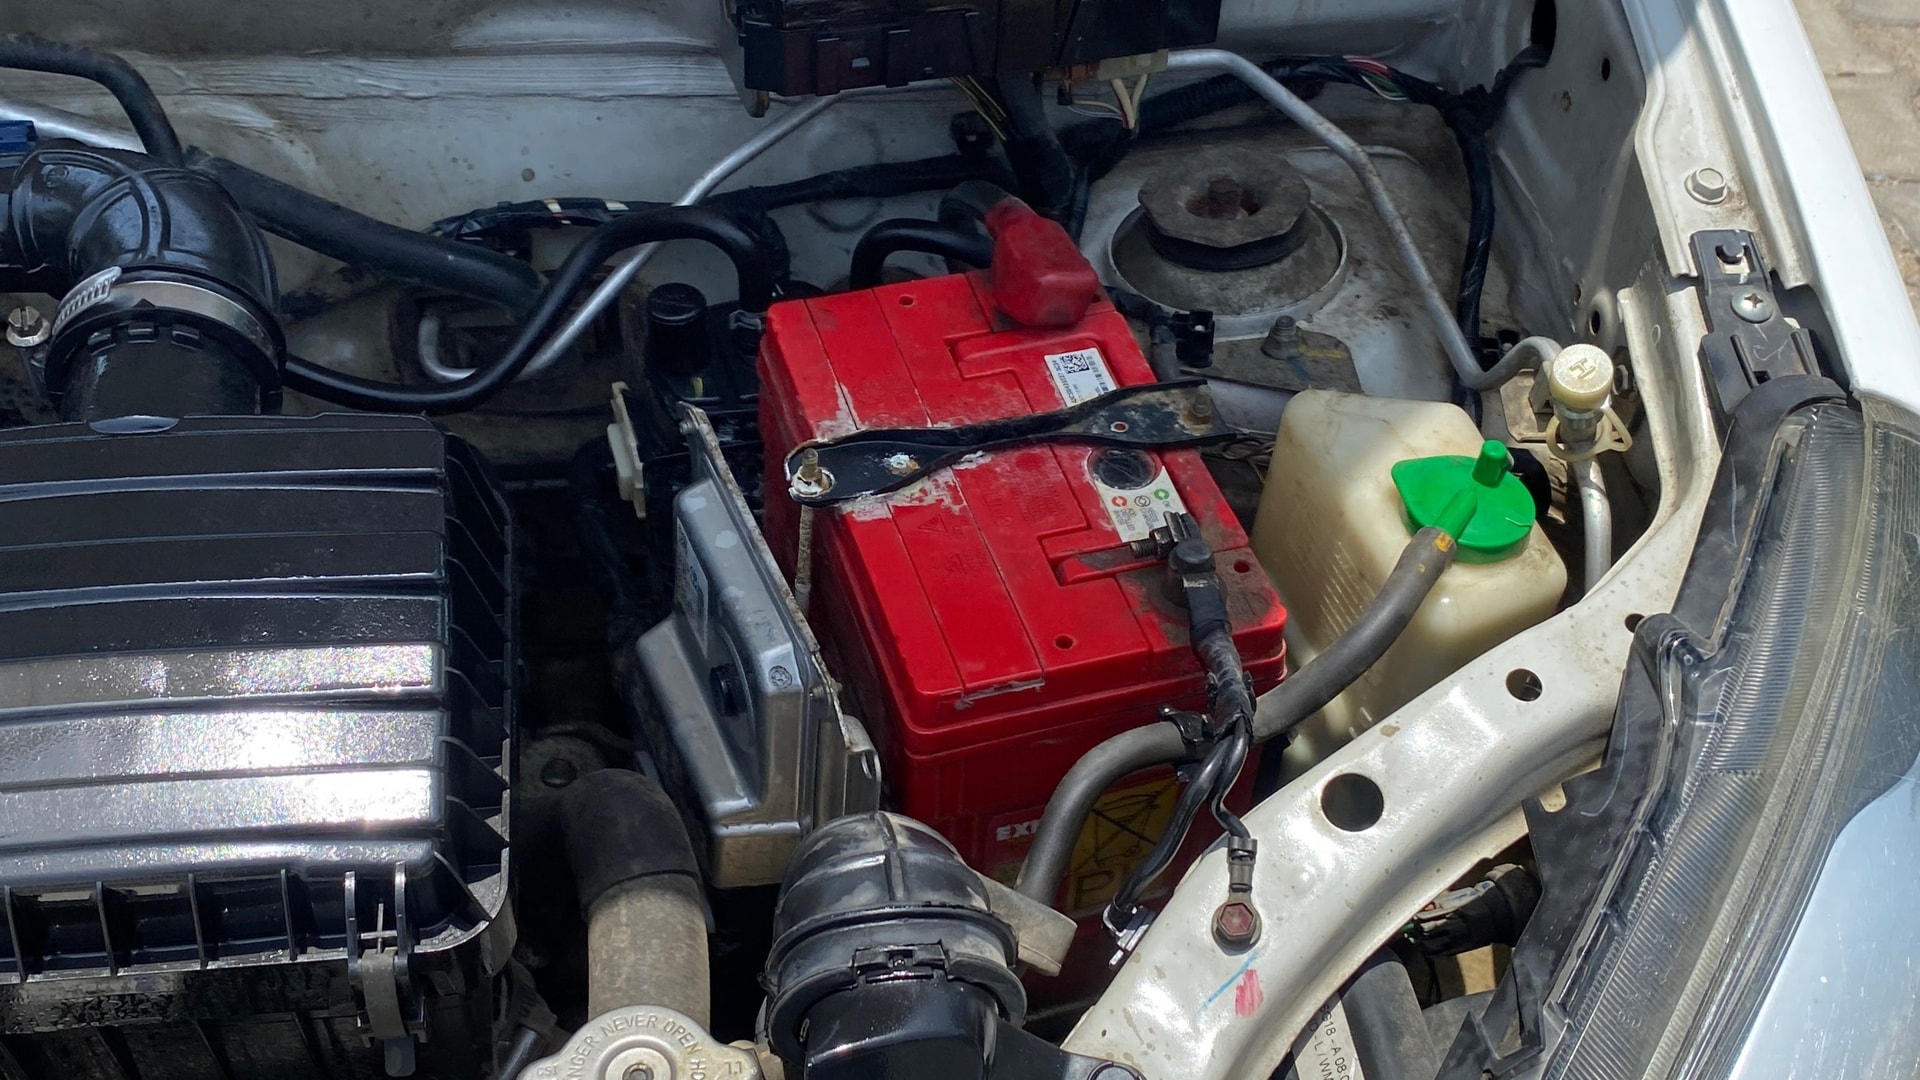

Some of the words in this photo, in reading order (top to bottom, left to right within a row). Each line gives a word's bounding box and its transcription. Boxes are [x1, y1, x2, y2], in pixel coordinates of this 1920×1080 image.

[1569, 357, 1597, 380] H
[600, 1014, 658, 1036] NEVER
[664, 1018, 702, 1054] OPEN
